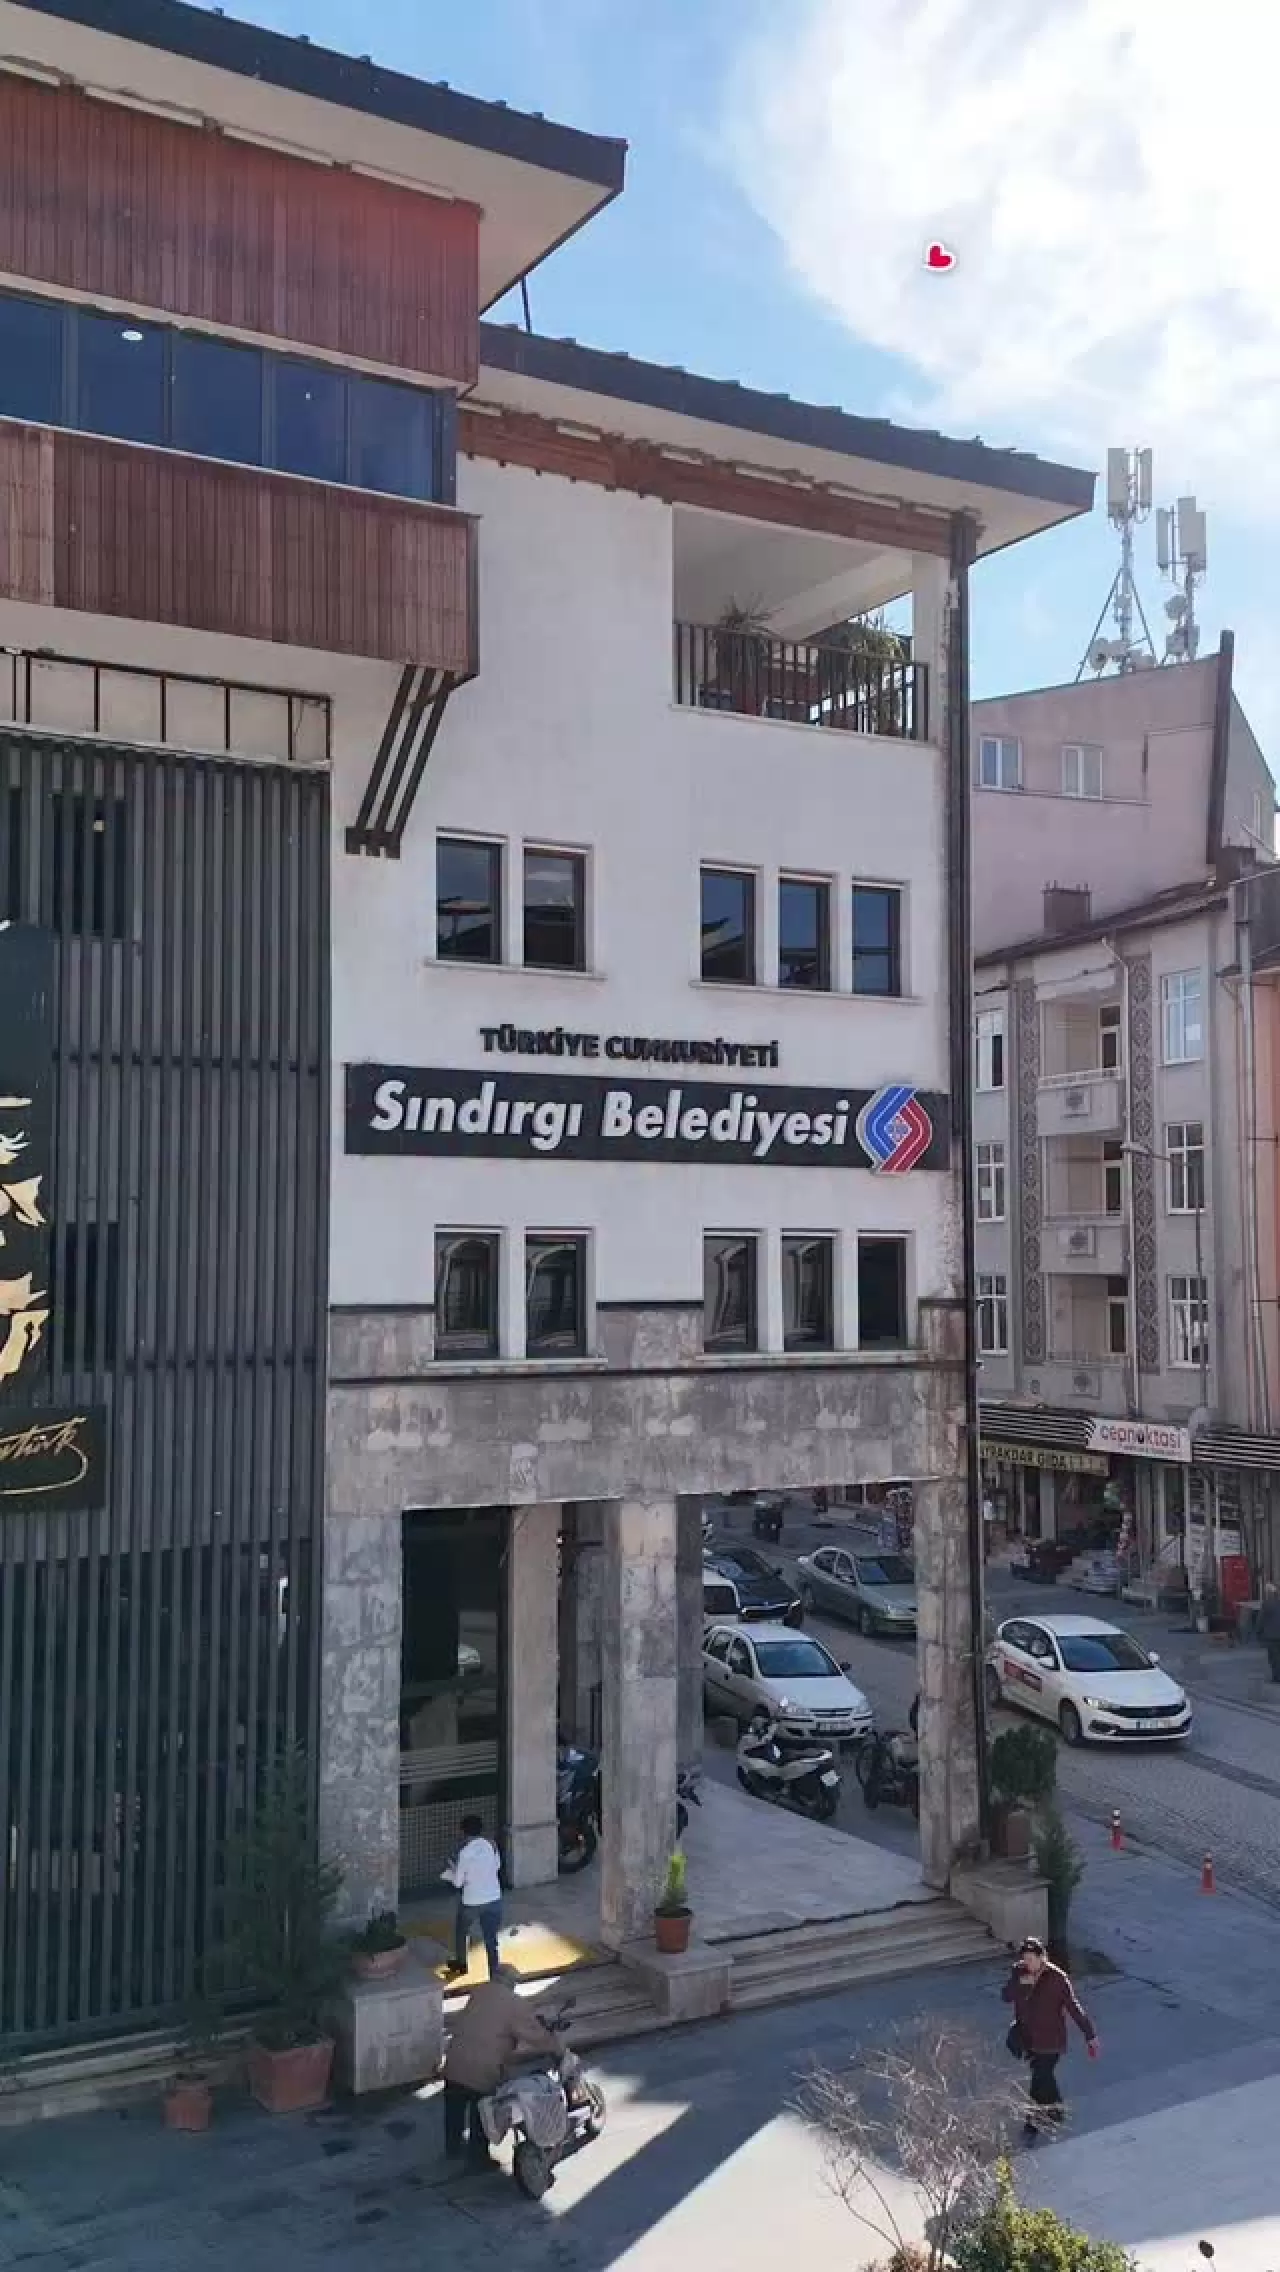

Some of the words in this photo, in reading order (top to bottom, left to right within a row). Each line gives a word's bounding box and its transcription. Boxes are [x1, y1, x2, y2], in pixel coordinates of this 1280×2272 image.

[479, 1023, 601, 1058] TÜRKİYE
[603, 1036, 780, 1069] CUMHURİYETİ
[370, 1080, 583, 1151] Sındırgı
[603, 1091, 848, 1157] Belediyesi
